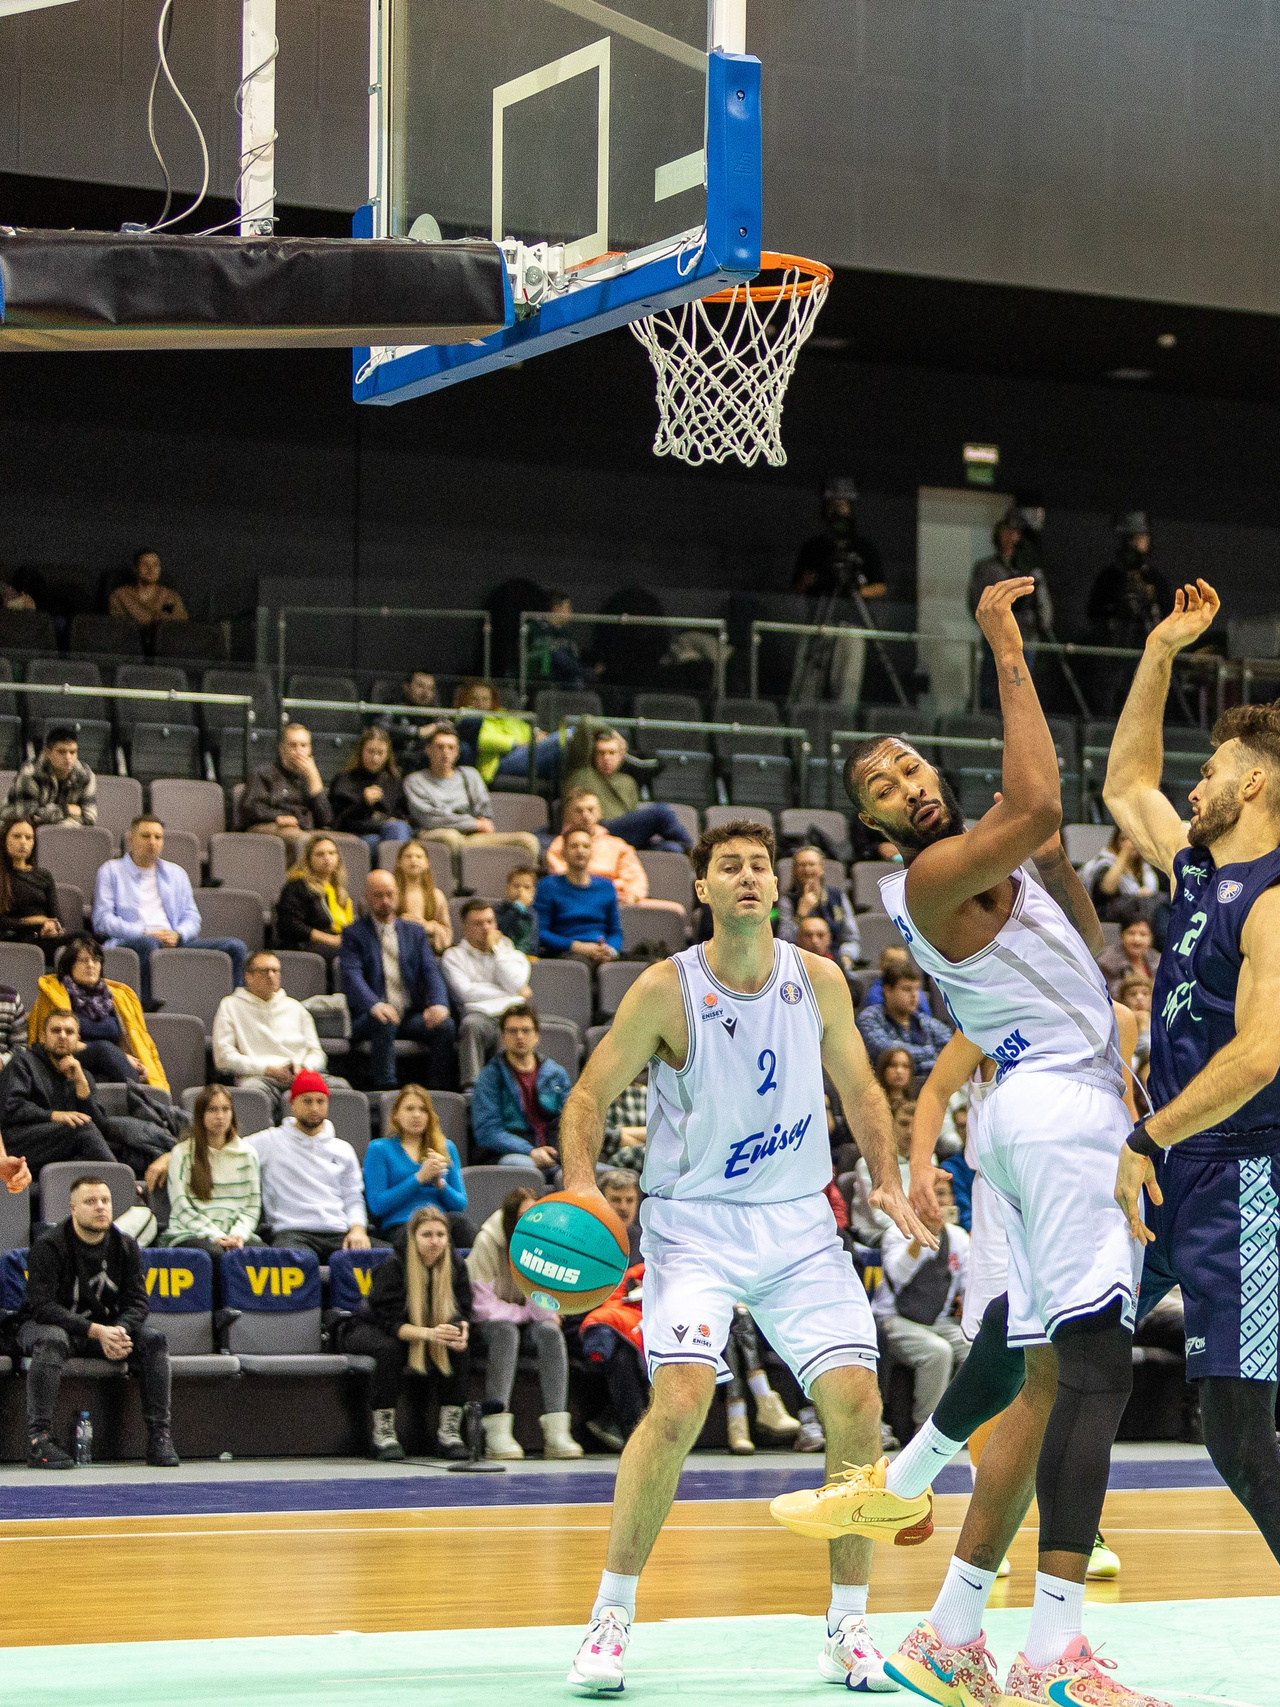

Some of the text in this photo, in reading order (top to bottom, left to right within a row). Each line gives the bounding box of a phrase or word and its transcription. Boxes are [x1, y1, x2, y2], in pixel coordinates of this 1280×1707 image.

[701, 1009, 724, 1021] ENISEY
[756, 1048, 778, 1097] 2
[724, 1113, 812, 1179] Enisey
[245, 1265, 305, 1297] VIP
[519, 1248, 582, 1285] SIBUR
